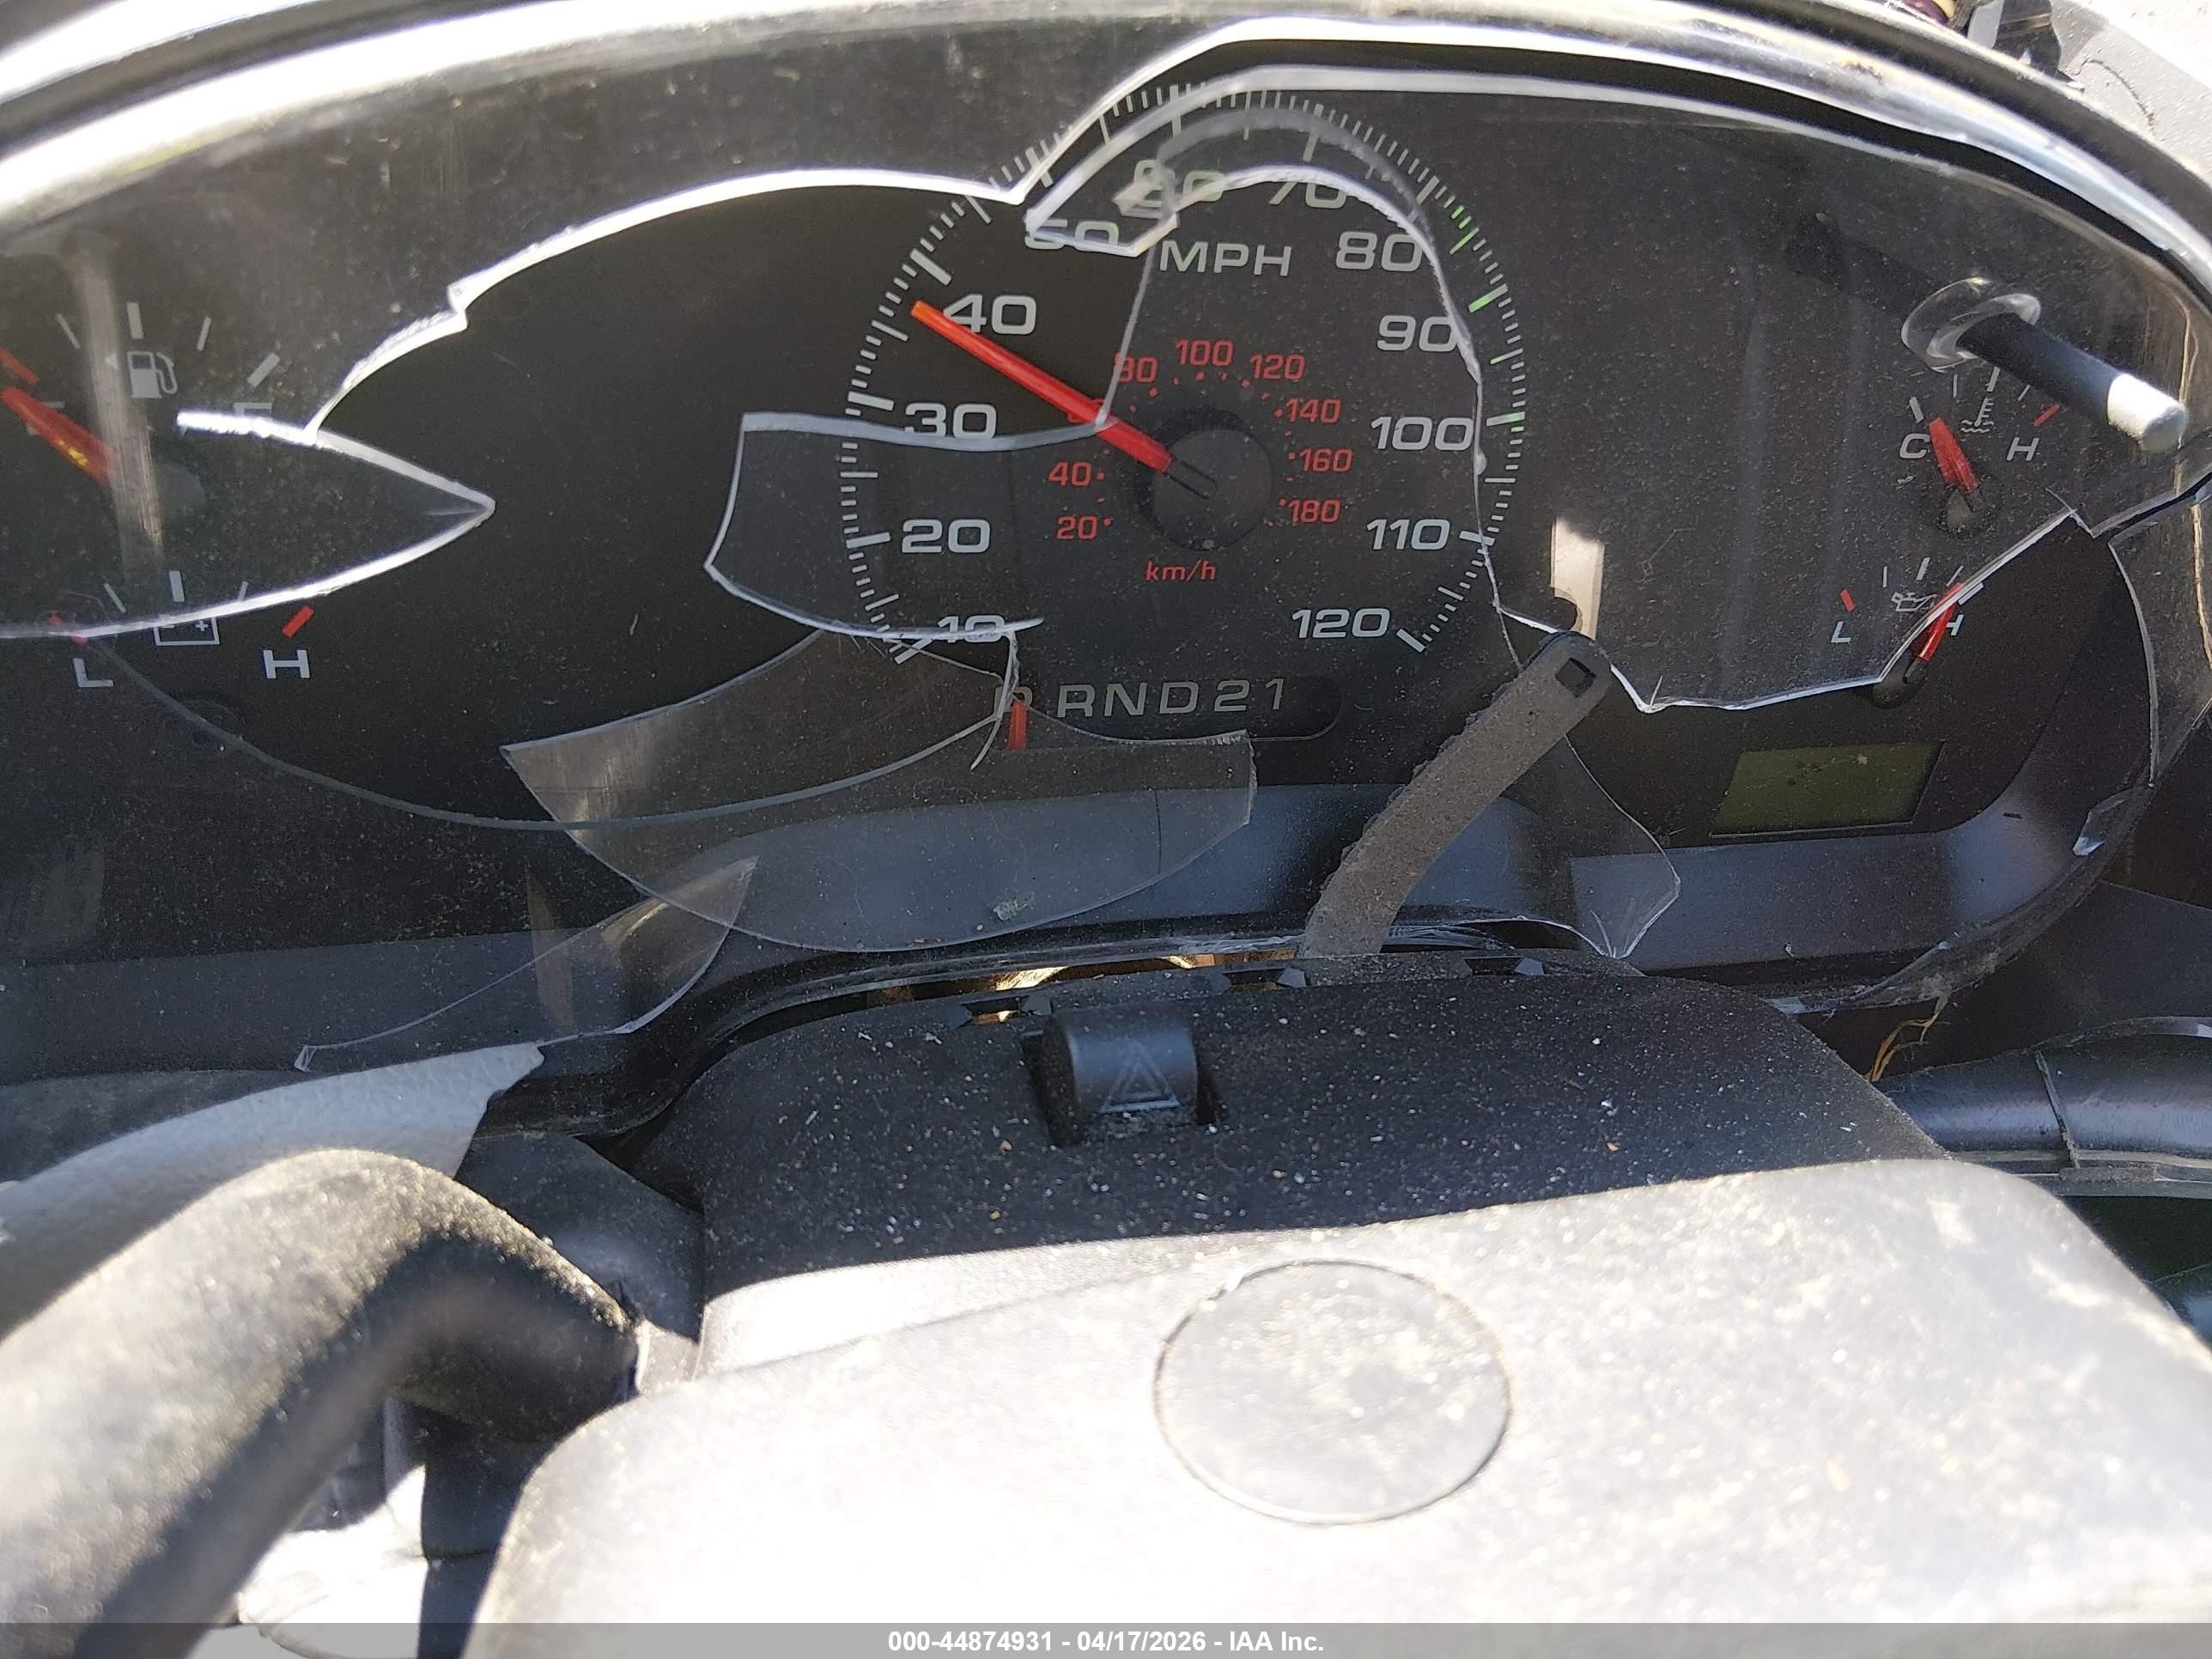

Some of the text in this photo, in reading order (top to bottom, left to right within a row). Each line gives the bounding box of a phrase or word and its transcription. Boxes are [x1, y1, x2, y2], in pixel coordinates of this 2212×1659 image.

[1159, 240, 1292, 277] MPH
[1335, 231, 1423, 273] 80
[943, 295, 1037, 337] 40
[1377, 314, 1459, 354] 90
[1175, 339, 1234, 367] 100
[1249, 353, 1306, 380] 120
[904, 403, 997, 442] 30
[1285, 398, 1341, 424] 140
[1370, 416, 1475, 452] 100
[1899, 433, 1930, 459] C
[1299, 448, 1353, 473] 160
[2007, 437, 2039, 461] H
[1048, 461, 1092, 487] 40
[1289, 499, 1341, 524] 180
[902, 519, 990, 554] 20
[1056, 515, 1098, 541] 20
[1365, 519, 1451, 551] 110
[1146, 560, 1218, 582] km/h
[1291, 608, 1390, 640] 120
[1831, 621, 1851, 644] L
[73, 658, 113, 687] L
[263, 649, 311, 679] H
